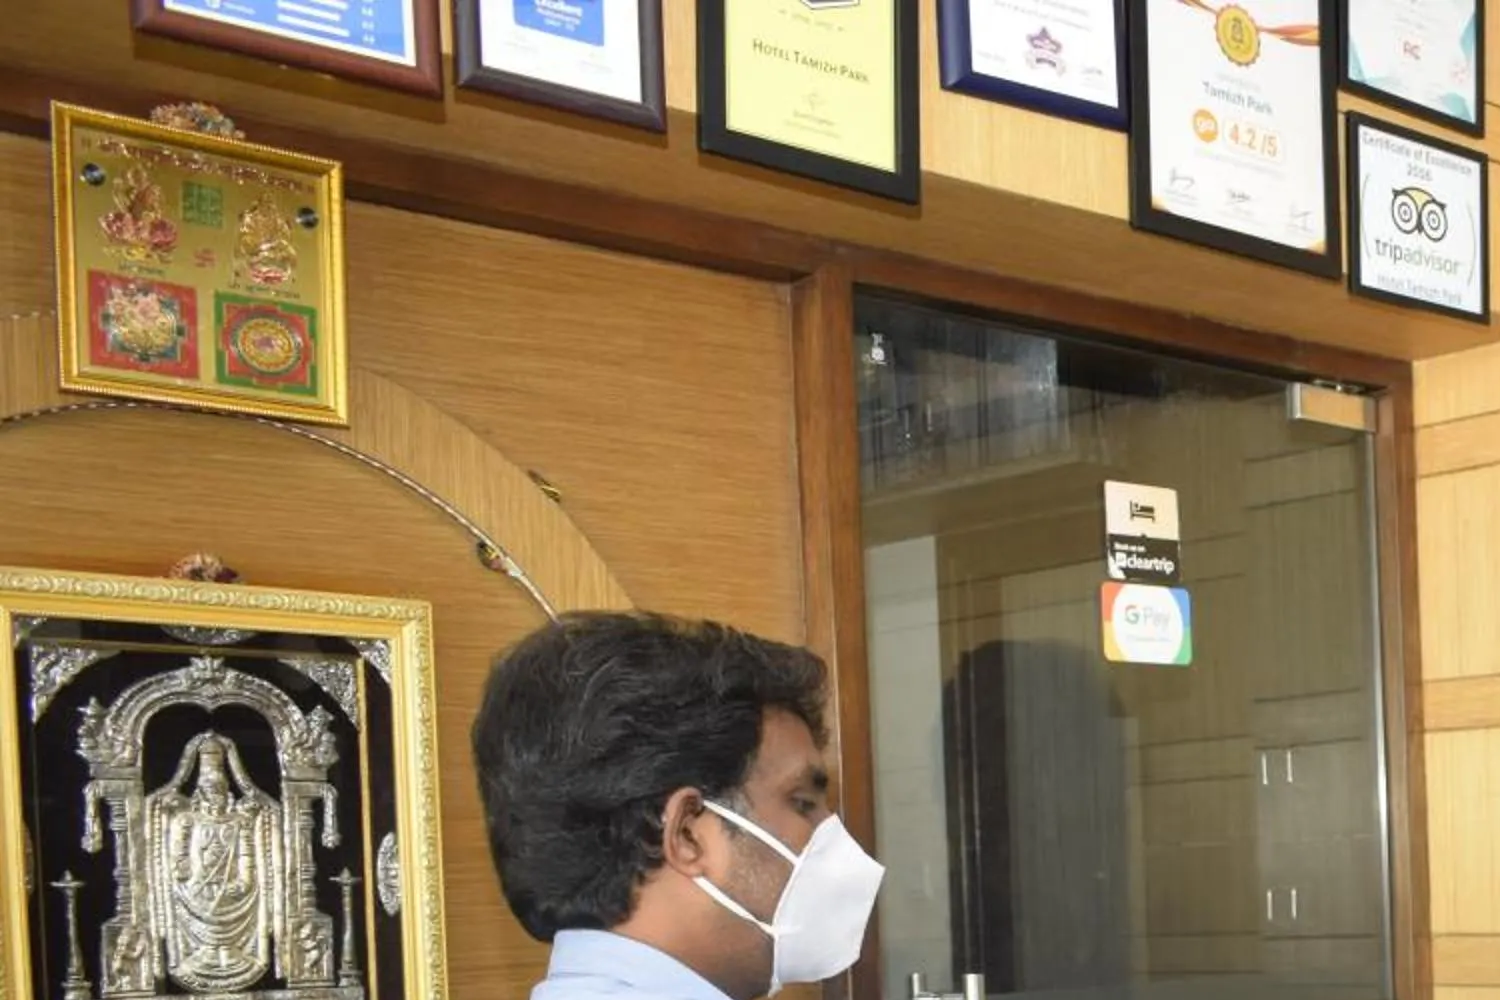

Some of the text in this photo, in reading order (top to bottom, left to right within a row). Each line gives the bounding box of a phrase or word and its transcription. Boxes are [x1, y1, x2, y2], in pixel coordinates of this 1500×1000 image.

[752, 37, 790, 62] HOTEL
[1374, 238, 1463, 276] tripadvisor
[1126, 553, 1175, 575] cleartrip
[1142, 605, 1172, 632] Pay
